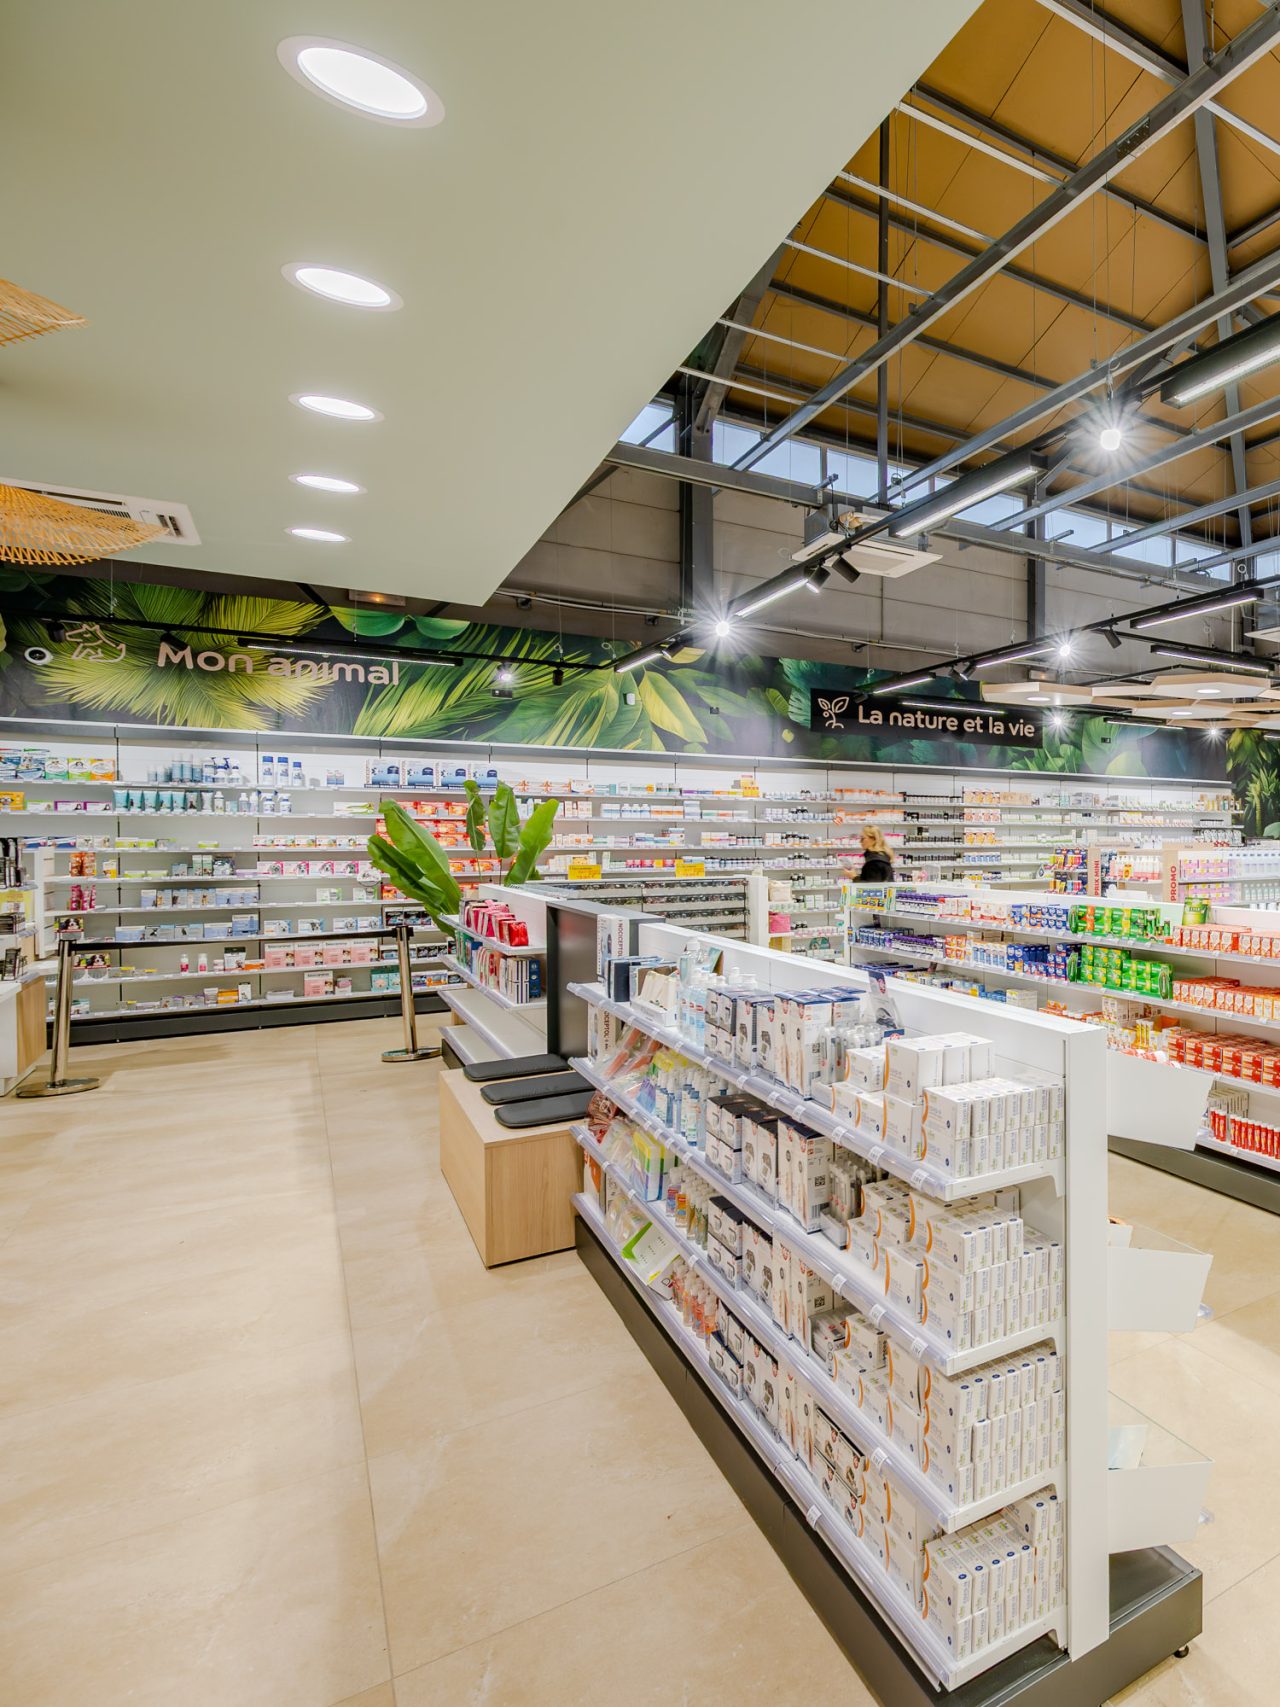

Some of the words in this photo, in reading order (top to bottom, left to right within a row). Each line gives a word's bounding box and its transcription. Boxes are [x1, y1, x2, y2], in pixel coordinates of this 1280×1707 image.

[157, 641, 253, 673] Mon
[267, 655, 399, 686] animal
[858, 705, 882, 725] La
[890, 712, 958, 731] nature
[963, 716, 982, 733] et
[989, 717, 1004, 735] la
[1009, 719, 1035, 737] vie
